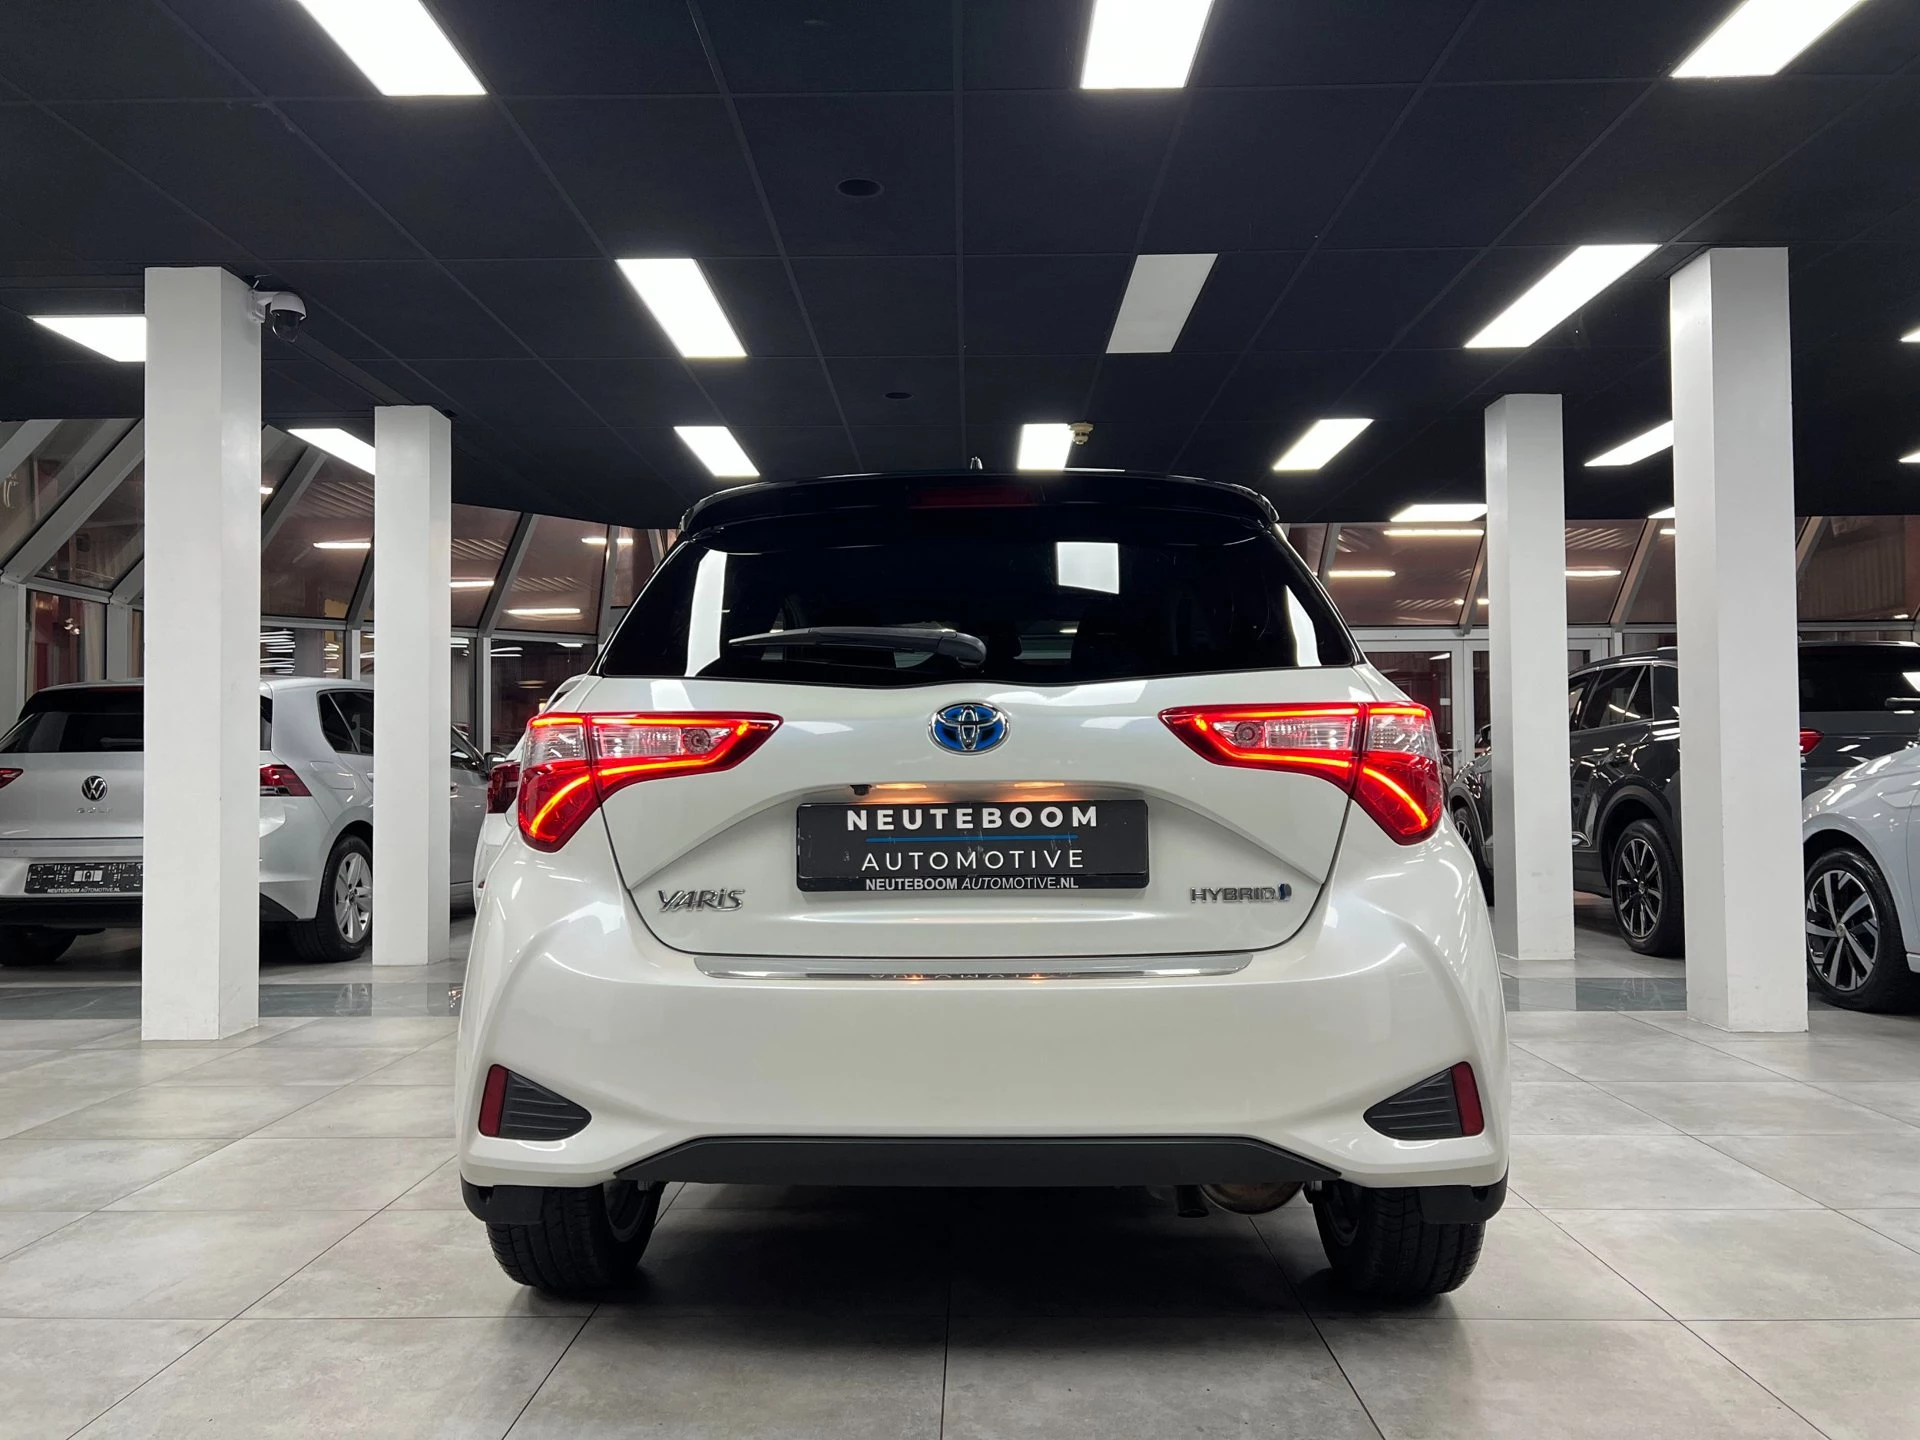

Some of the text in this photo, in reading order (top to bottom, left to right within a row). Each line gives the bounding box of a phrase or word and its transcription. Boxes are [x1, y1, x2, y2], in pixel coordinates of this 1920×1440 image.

[847, 806, 1097, 831] NEUTEBOOM
[861, 849, 1083, 871] AUTOMOTIVE
[866, 877, 1079, 890] NEUTEBOOM AUTOMOTIVE.NL
[658, 888, 746, 912] YARIS
[1190, 887, 1276, 903] HYBRID
